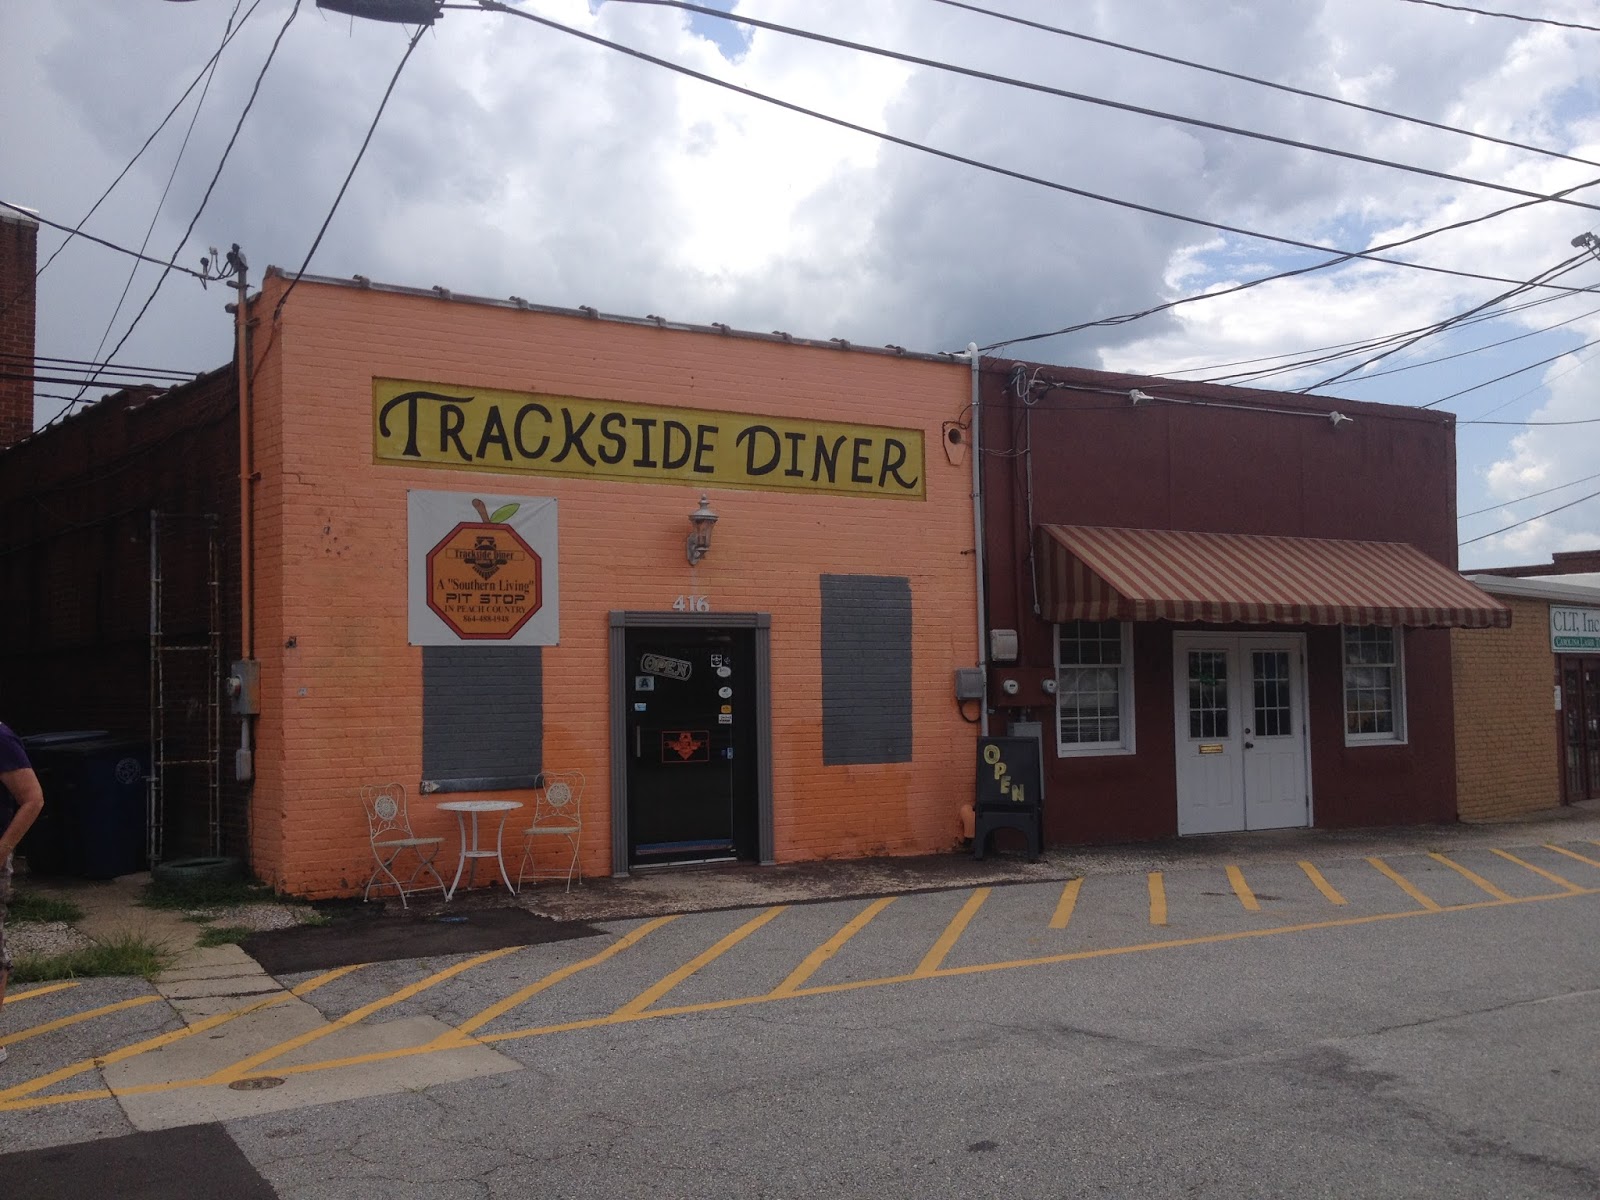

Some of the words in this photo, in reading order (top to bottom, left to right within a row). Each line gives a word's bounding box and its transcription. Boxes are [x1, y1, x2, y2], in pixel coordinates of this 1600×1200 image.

[378, 391, 719, 474] TRACKSIDE
[736, 425, 919, 490] DINER
[437, 579, 445, 590] A
[448, 578, 496, 591] "Southern
[499, 579, 534, 594] Living"
[446, 593, 472, 604] PIT
[480, 594, 525, 604] STOP
[673, 594, 710, 612] 416
[444, 605, 454, 613] IN
[457, 605, 484, 613] PEACH
[486, 605, 526, 614] COUNTRY
[1554, 611, 1579, 635] CLT,
[644, 655, 690, 678] OPEN
[984, 744, 1025, 802] OPEN
